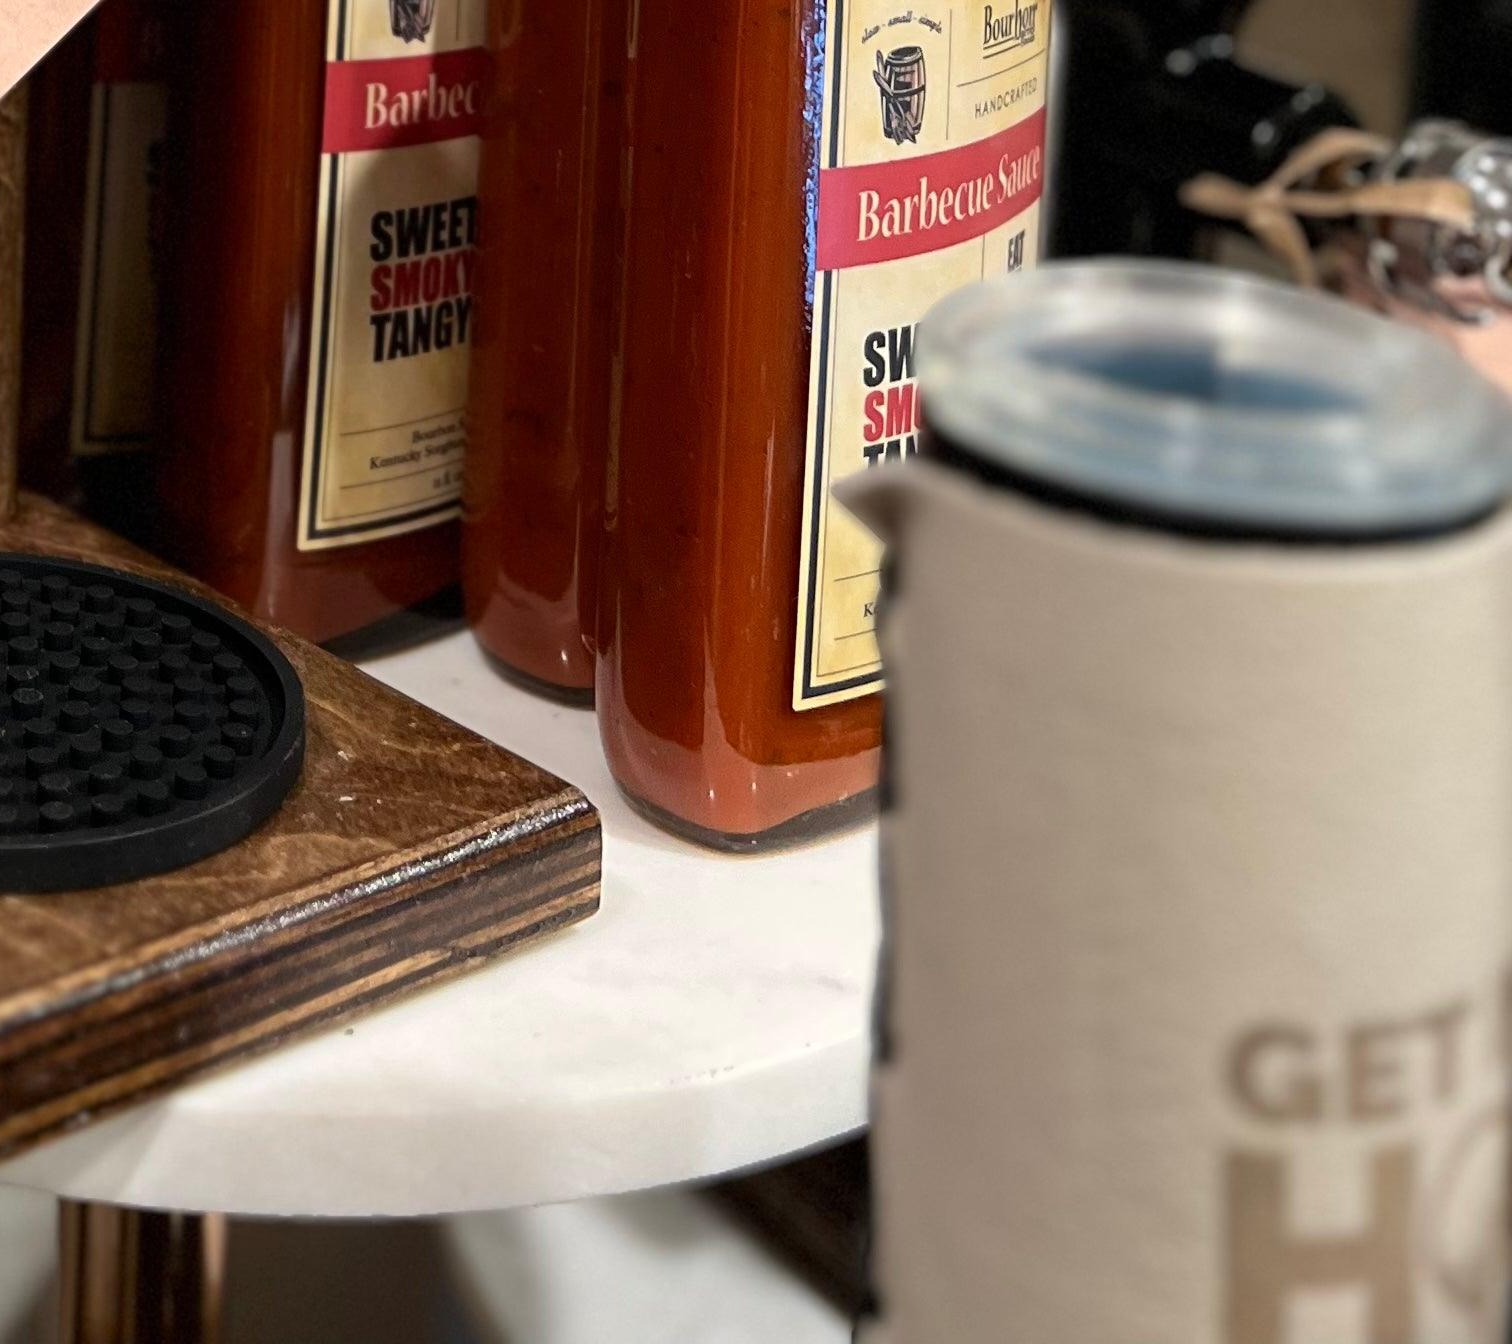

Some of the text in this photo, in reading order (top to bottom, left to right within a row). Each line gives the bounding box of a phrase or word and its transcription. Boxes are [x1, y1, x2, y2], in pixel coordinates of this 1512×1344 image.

[364, 72, 480, 129] Barbec
[974, 76, 1038, 119] HANDCRAFTED
[856, 144, 1042, 242] Barbecue Sauce
[370, 196, 478, 261] SWEET
[370, 295, 473, 363] TANGY
[1224, 994, 1470, 1127] GET
